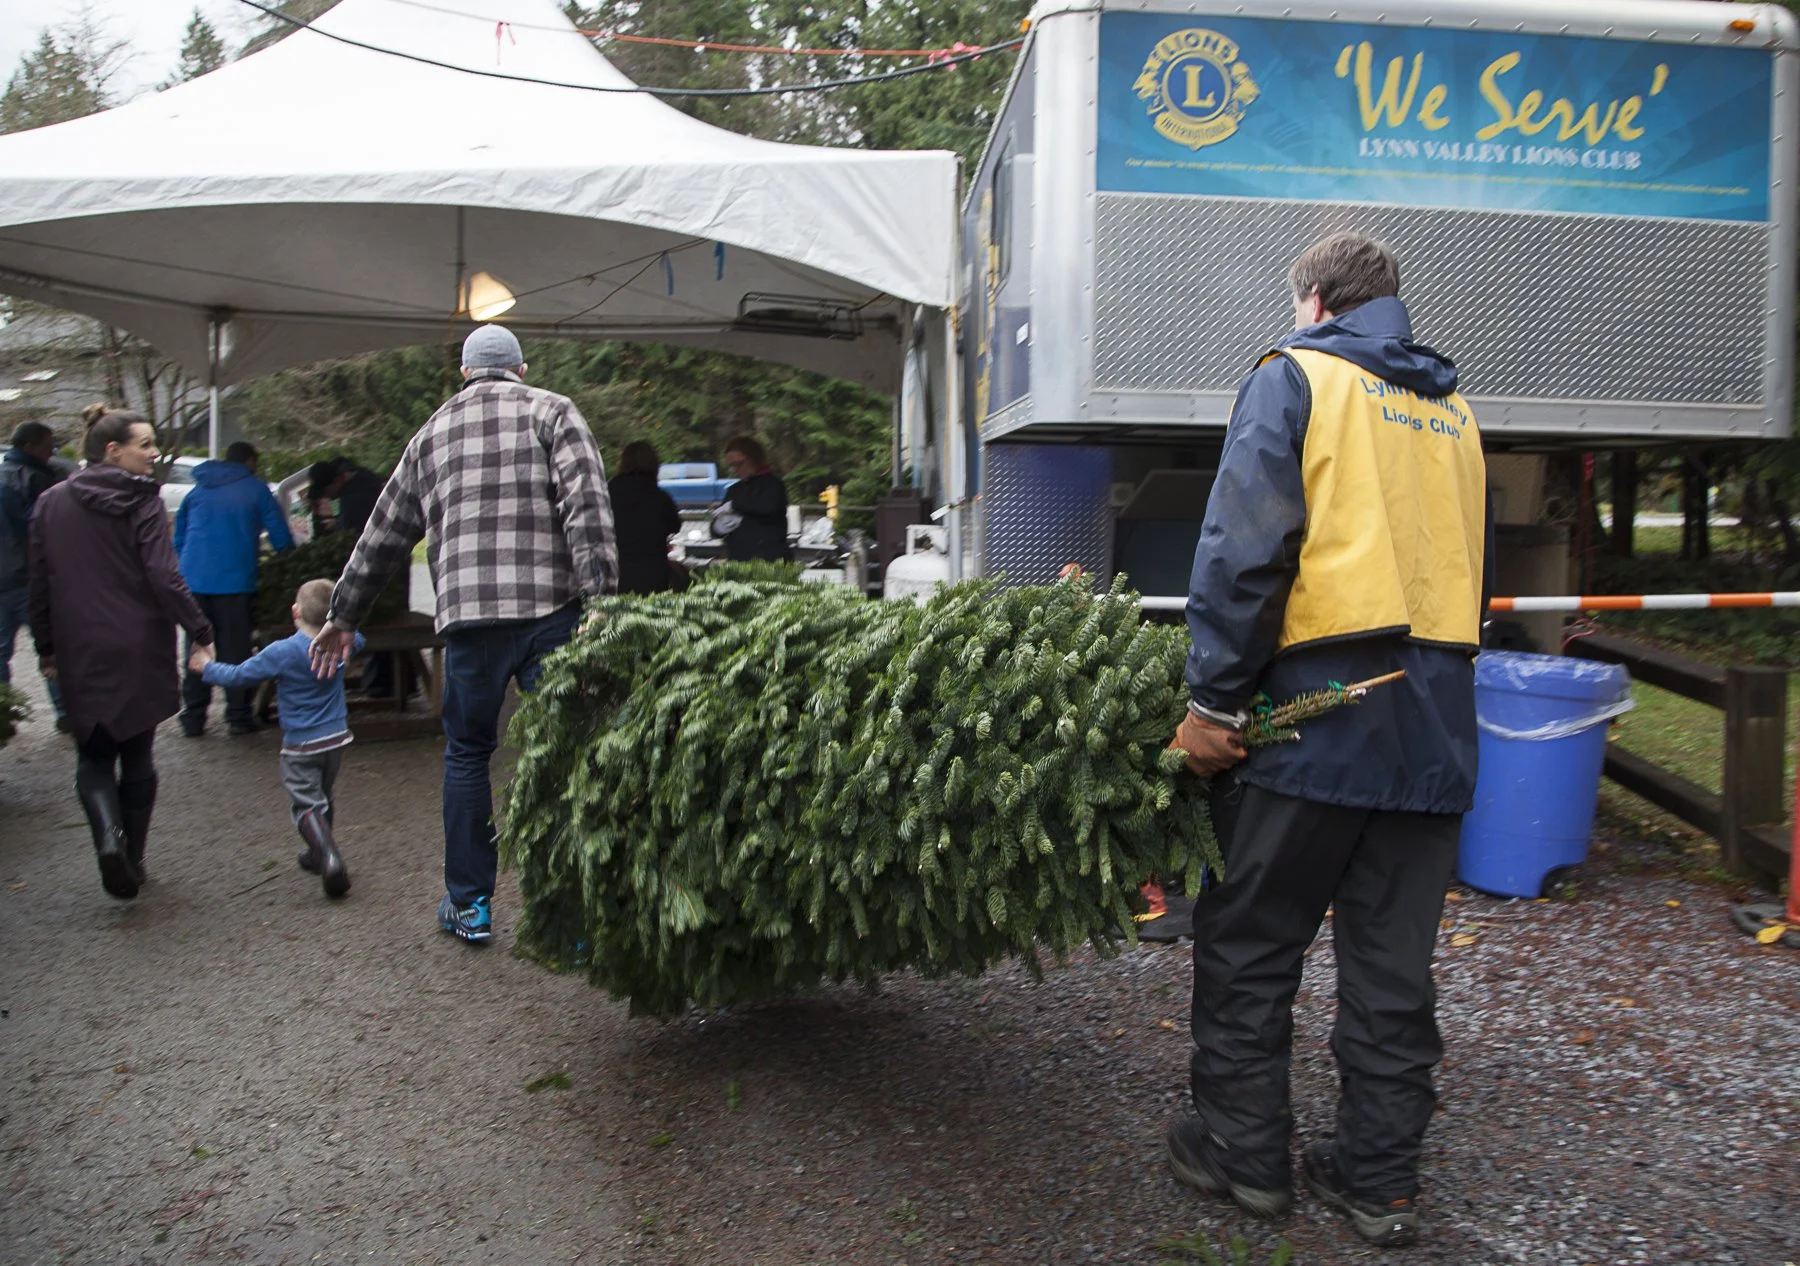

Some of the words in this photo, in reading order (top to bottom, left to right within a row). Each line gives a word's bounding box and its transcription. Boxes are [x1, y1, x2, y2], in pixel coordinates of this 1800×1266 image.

[1160, 32, 1233, 60] LIONS
[1181, 65, 1217, 108] L
[1358, 137, 1420, 159] LYNN
[1423, 140, 1511, 164] VALLEY
[1512, 145, 1579, 167] LIONS
[1580, 149, 1642, 170] CLUB
[1429, 417, 1461, 440] Club
